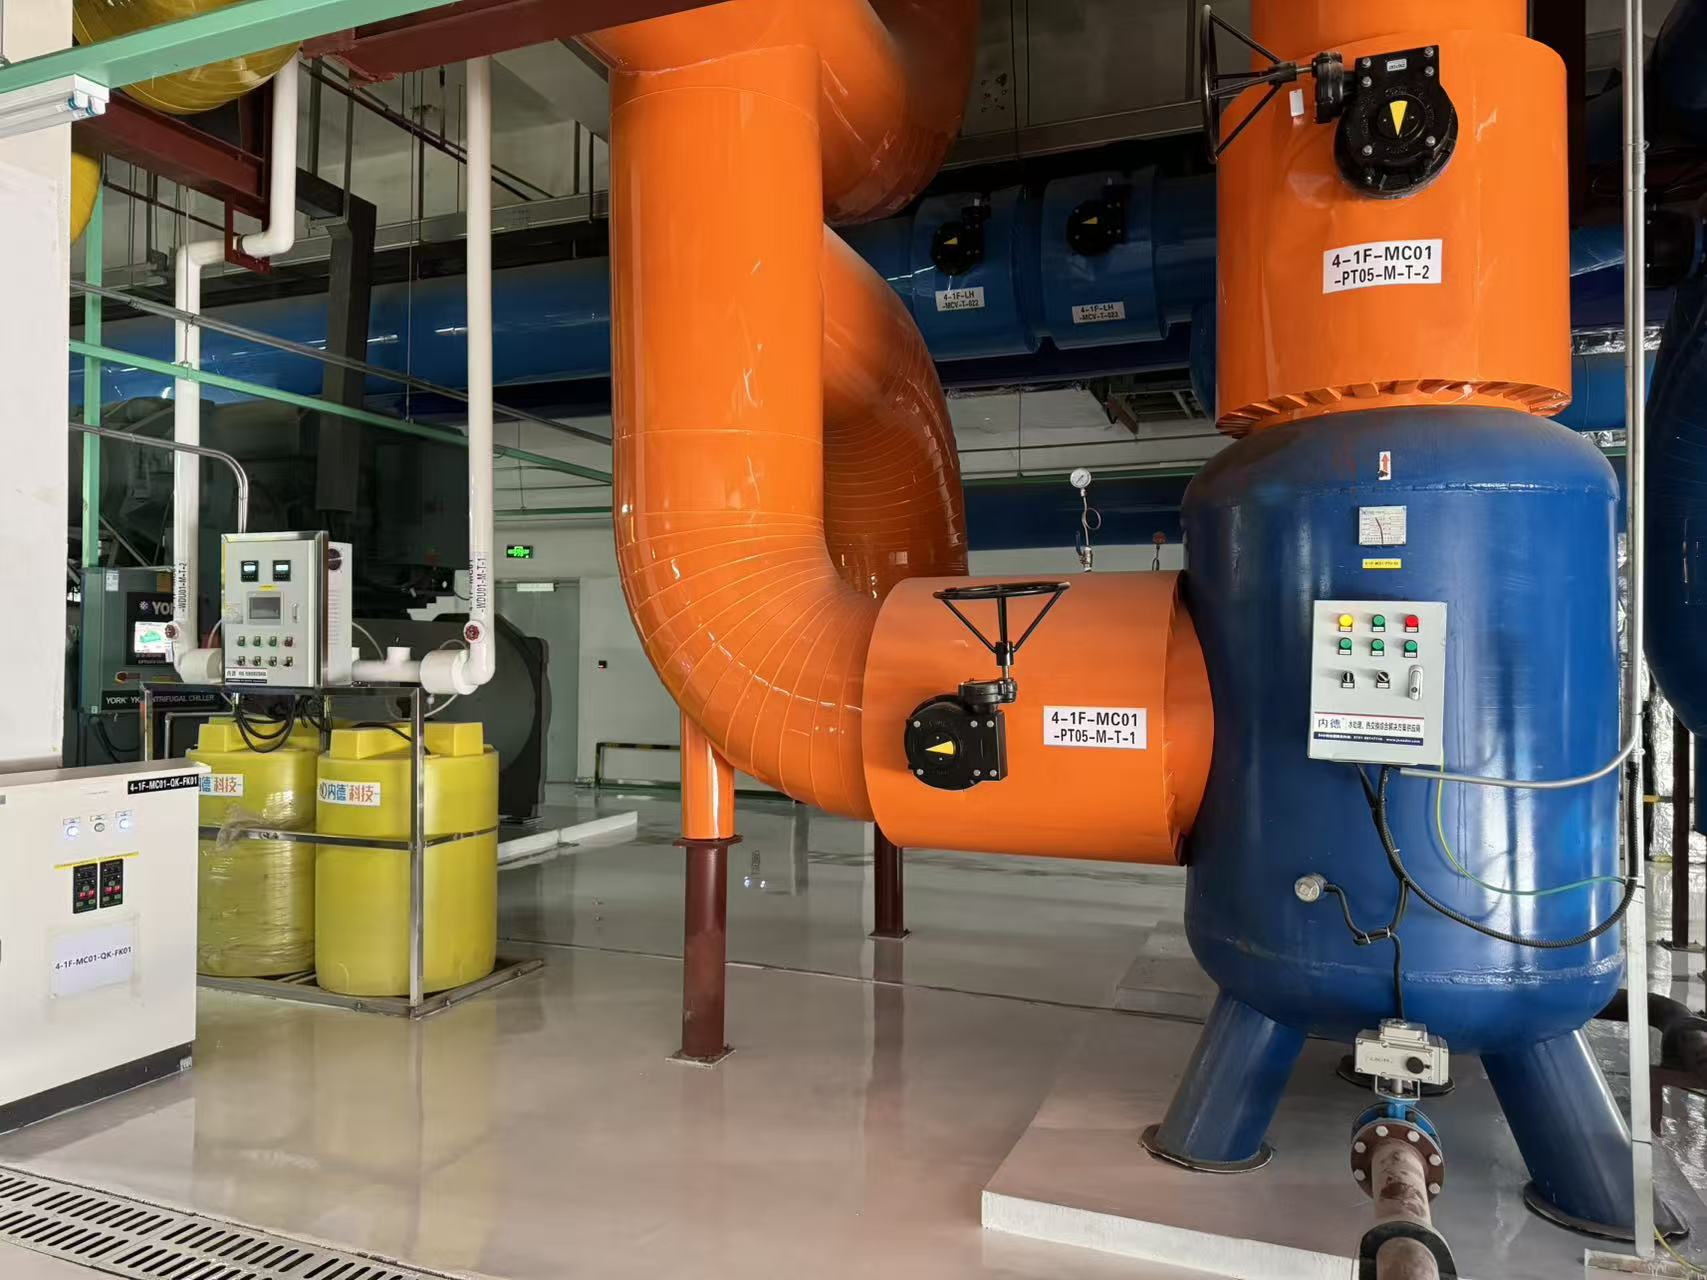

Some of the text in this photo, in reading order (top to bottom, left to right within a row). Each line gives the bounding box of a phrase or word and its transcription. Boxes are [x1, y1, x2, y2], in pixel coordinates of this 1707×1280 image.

[1332, 245, 1432, 268] 4-1F-MC01
[1334, 265, 1430, 286] -PT05-M-T-2
[943, 291, 975, 301] 4-1F-LH
[1080, 304, 1115, 314] 4-1F-LH
[1051, 711, 1138, 727] 4-1F-MC01
[1053, 728, 1136, 745] -PT05-M-T-1
[129, 775, 198, 792] 4-1F-MC01-QK-FK01
[55, 946, 132, 970] 4-1F-MC01-QK-FK01
